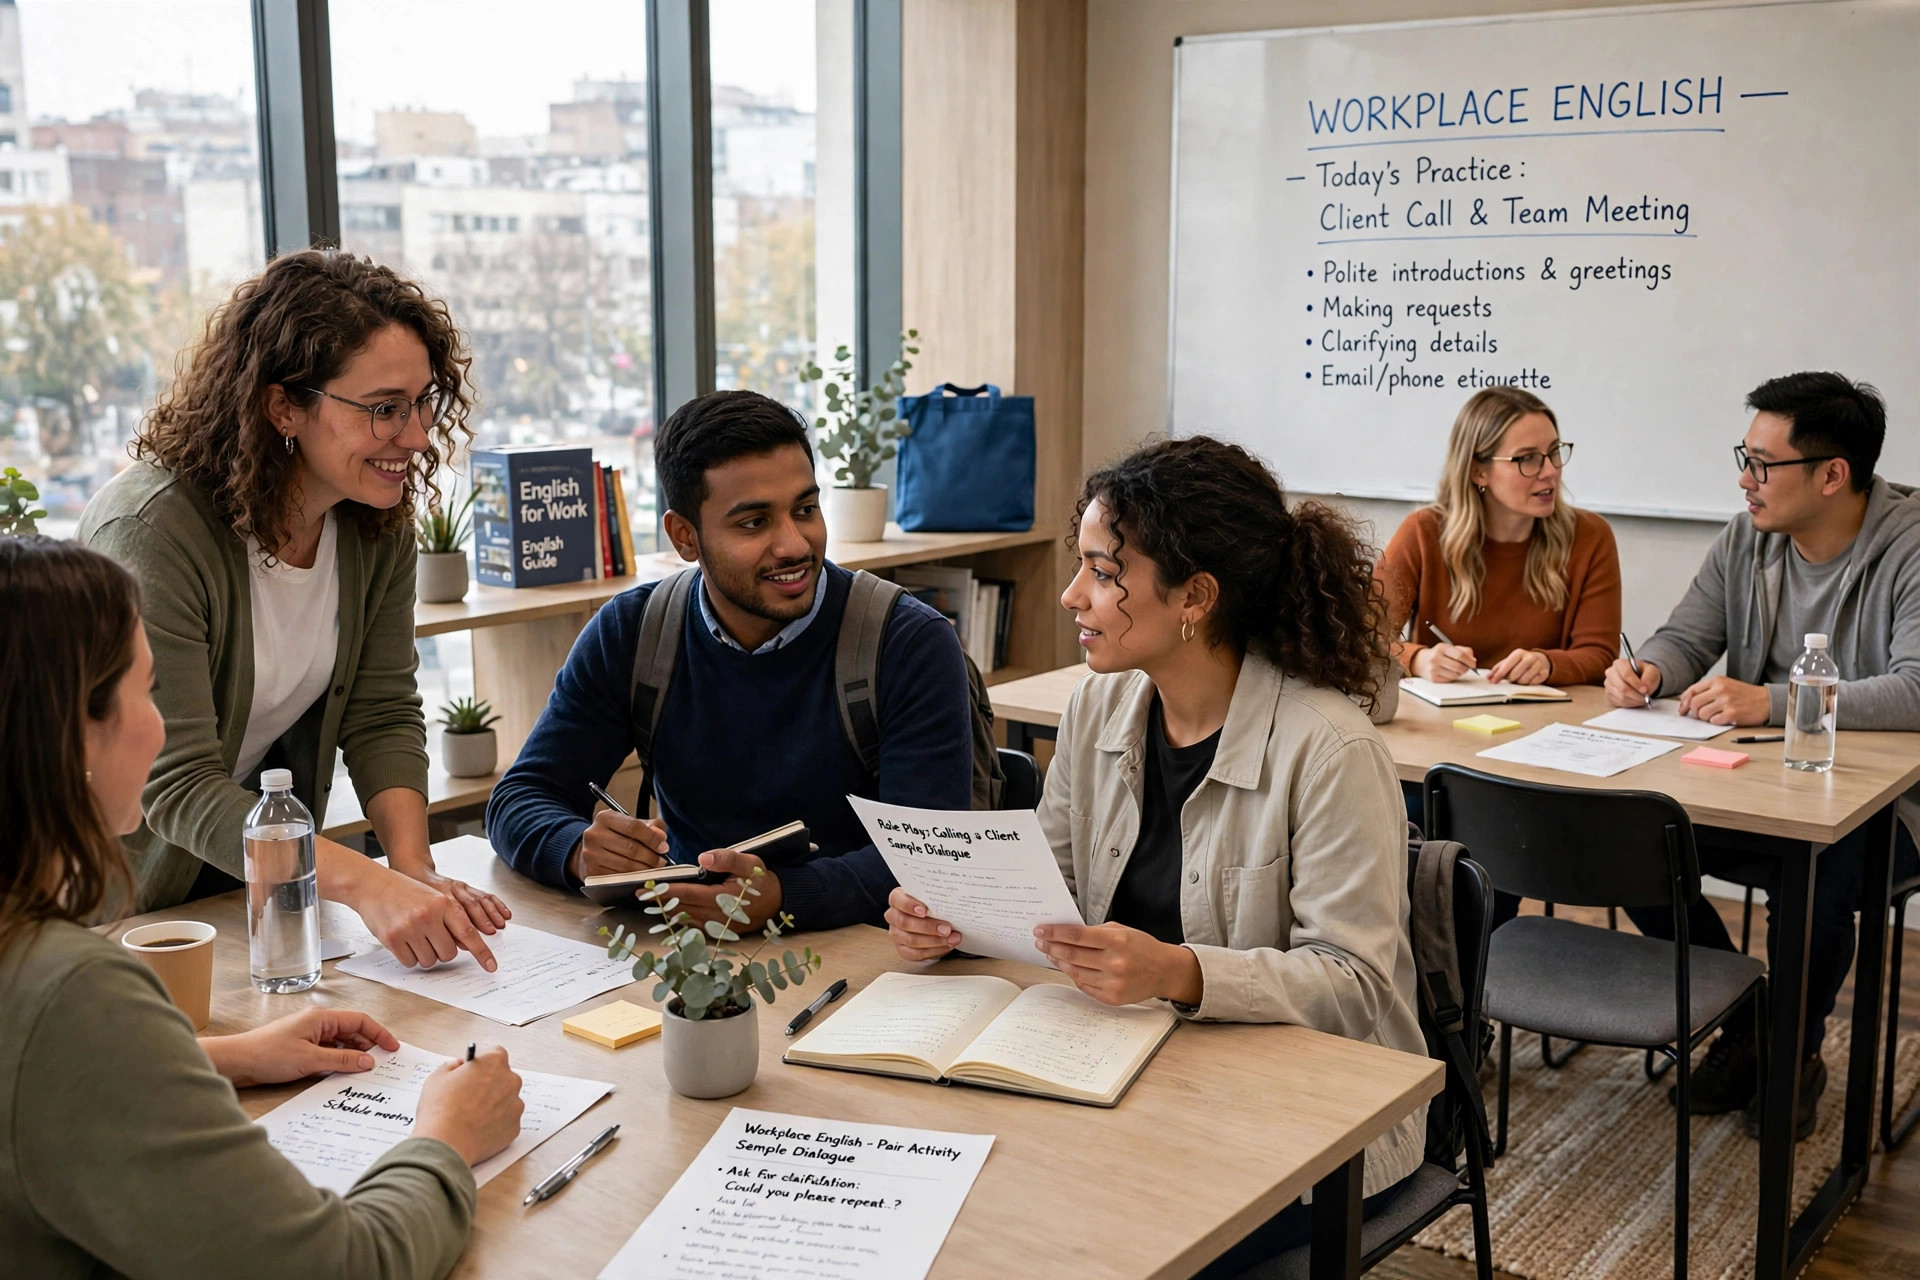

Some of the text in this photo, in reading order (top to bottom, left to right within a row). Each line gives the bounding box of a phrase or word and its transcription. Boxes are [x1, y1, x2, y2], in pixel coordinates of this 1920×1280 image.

[1308, 76, 1722, 134] WORKPLACE ENGLISH
[1316, 161, 1400, 196] Today's
[1319, 194, 1690, 234] Client Call & Team Meeting
[1324, 256, 1672, 291] Polite introductions & greetings
[1323, 296, 1492, 328] Making requests
[1321, 329, 1498, 362] Clarifying details
[1322, 363, 1445, 395] Email/phone
[520, 477, 580, 504] English
[521, 498, 588, 524] for Work
[521, 536, 564, 558] English
[522, 553, 557, 571] Guide
[887, 837, 923, 855] Sample
[984, 829, 1021, 841] Client
[815, 1132, 863, 1149] English
[907, 1143, 962, 1161] Activity
[724, 1180, 763, 1194] Could
[767, 1189, 790, 1199] you
